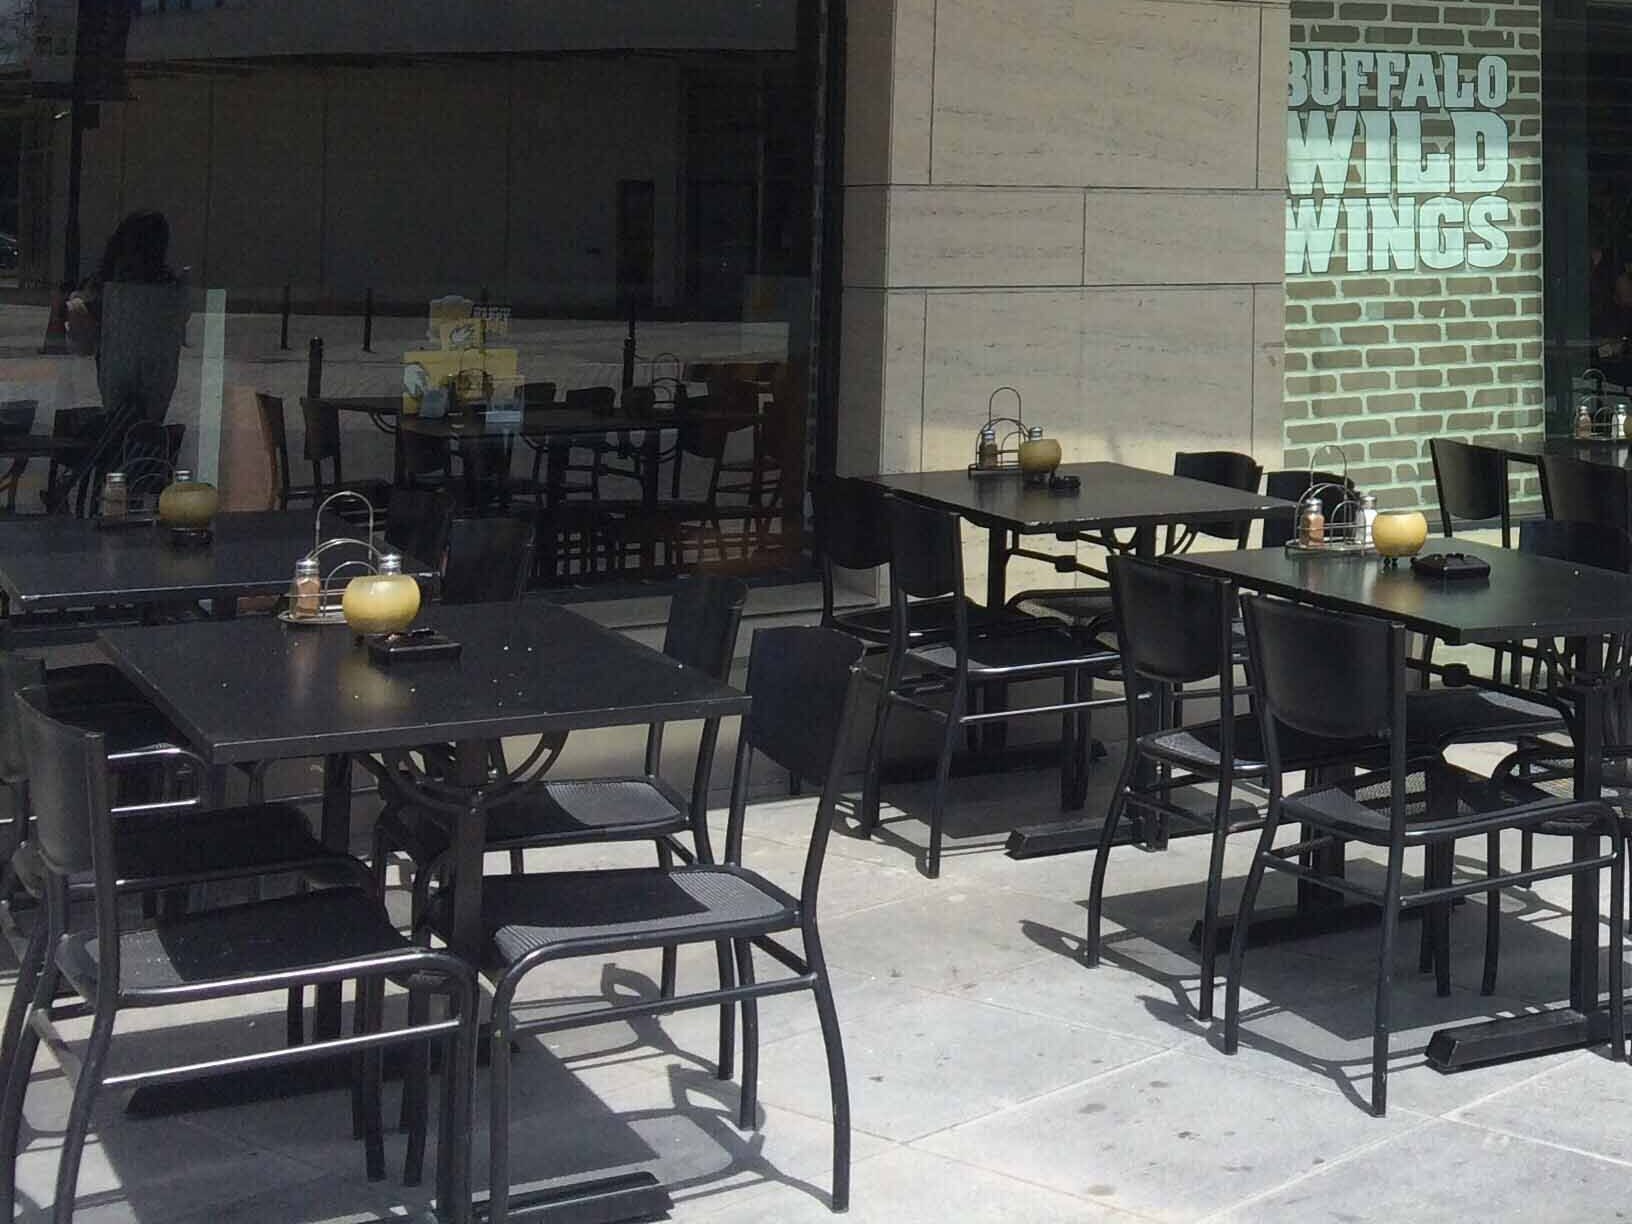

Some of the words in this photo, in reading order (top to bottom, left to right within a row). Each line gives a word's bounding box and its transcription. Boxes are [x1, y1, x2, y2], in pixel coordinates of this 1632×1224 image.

[1287, 48, 1509, 110] BUFFALO
[1286, 110, 1510, 194] WILD
[1284, 196, 1510, 274] WINGS
